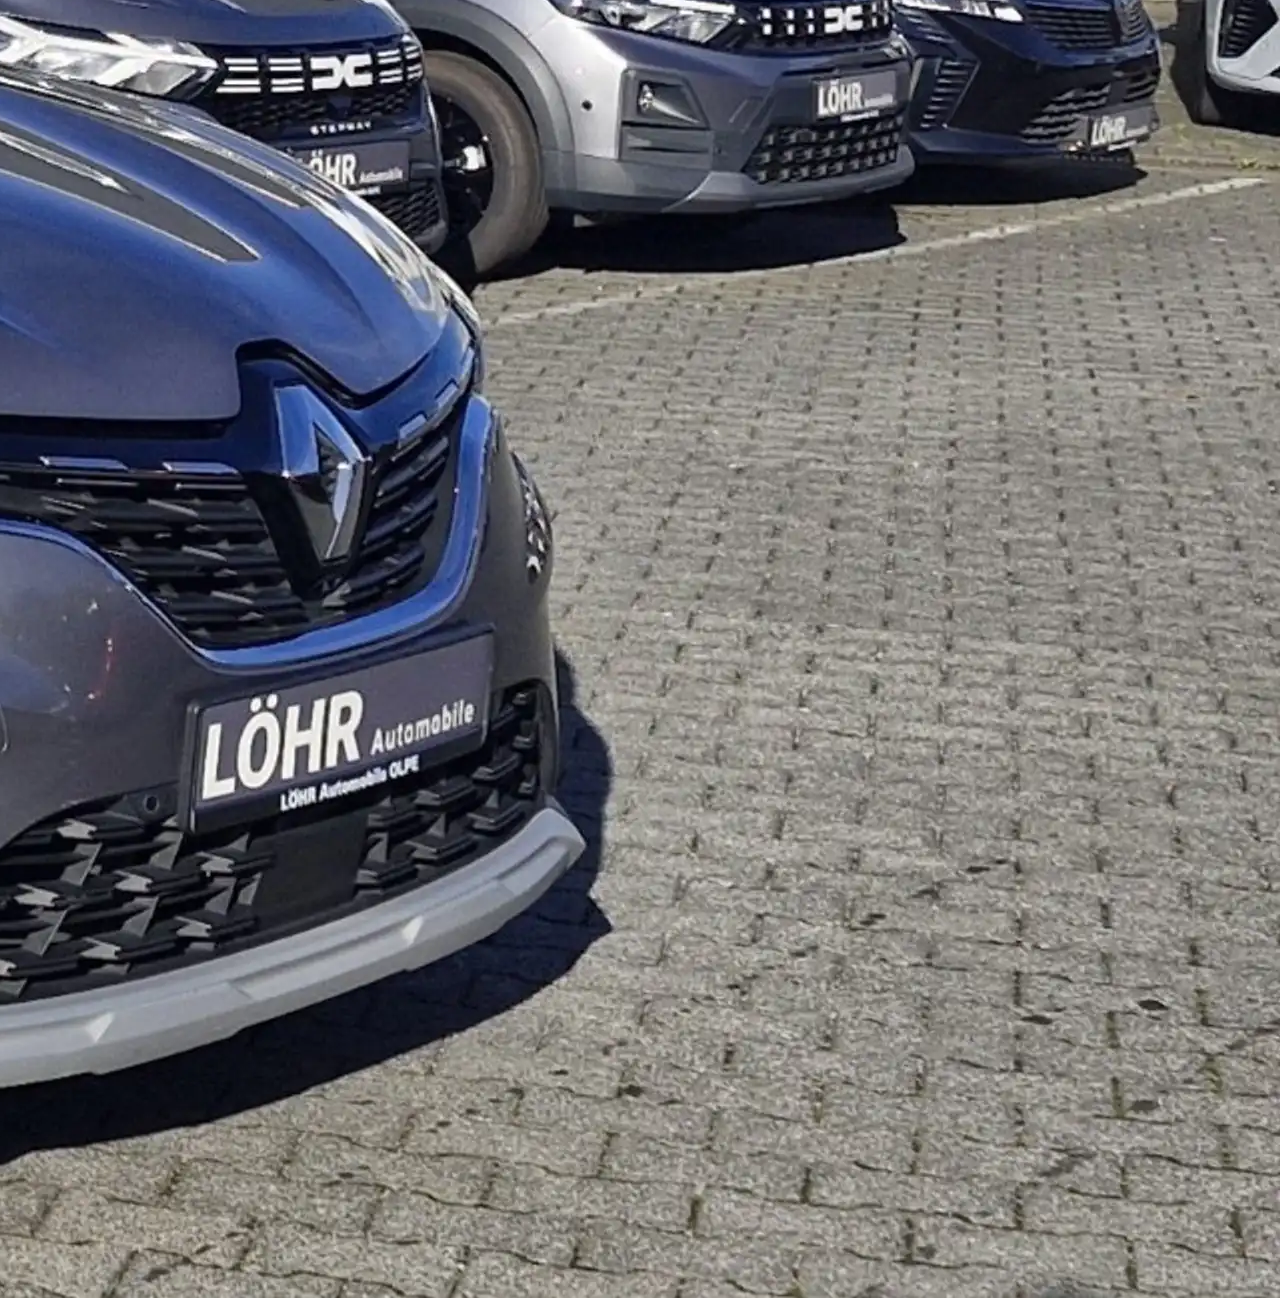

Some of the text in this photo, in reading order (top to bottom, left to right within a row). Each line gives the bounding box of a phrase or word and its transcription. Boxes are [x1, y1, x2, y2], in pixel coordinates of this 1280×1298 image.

[817, 78, 863, 118] LÖHR
[1090, 115, 1126, 147] LÖHR
[298, 148, 357, 186] ÖHR
[202, 690, 475, 800] LÖHR Automobile
[280, 786, 317, 813] LÖHR
[319, 766, 388, 801] Automobile
